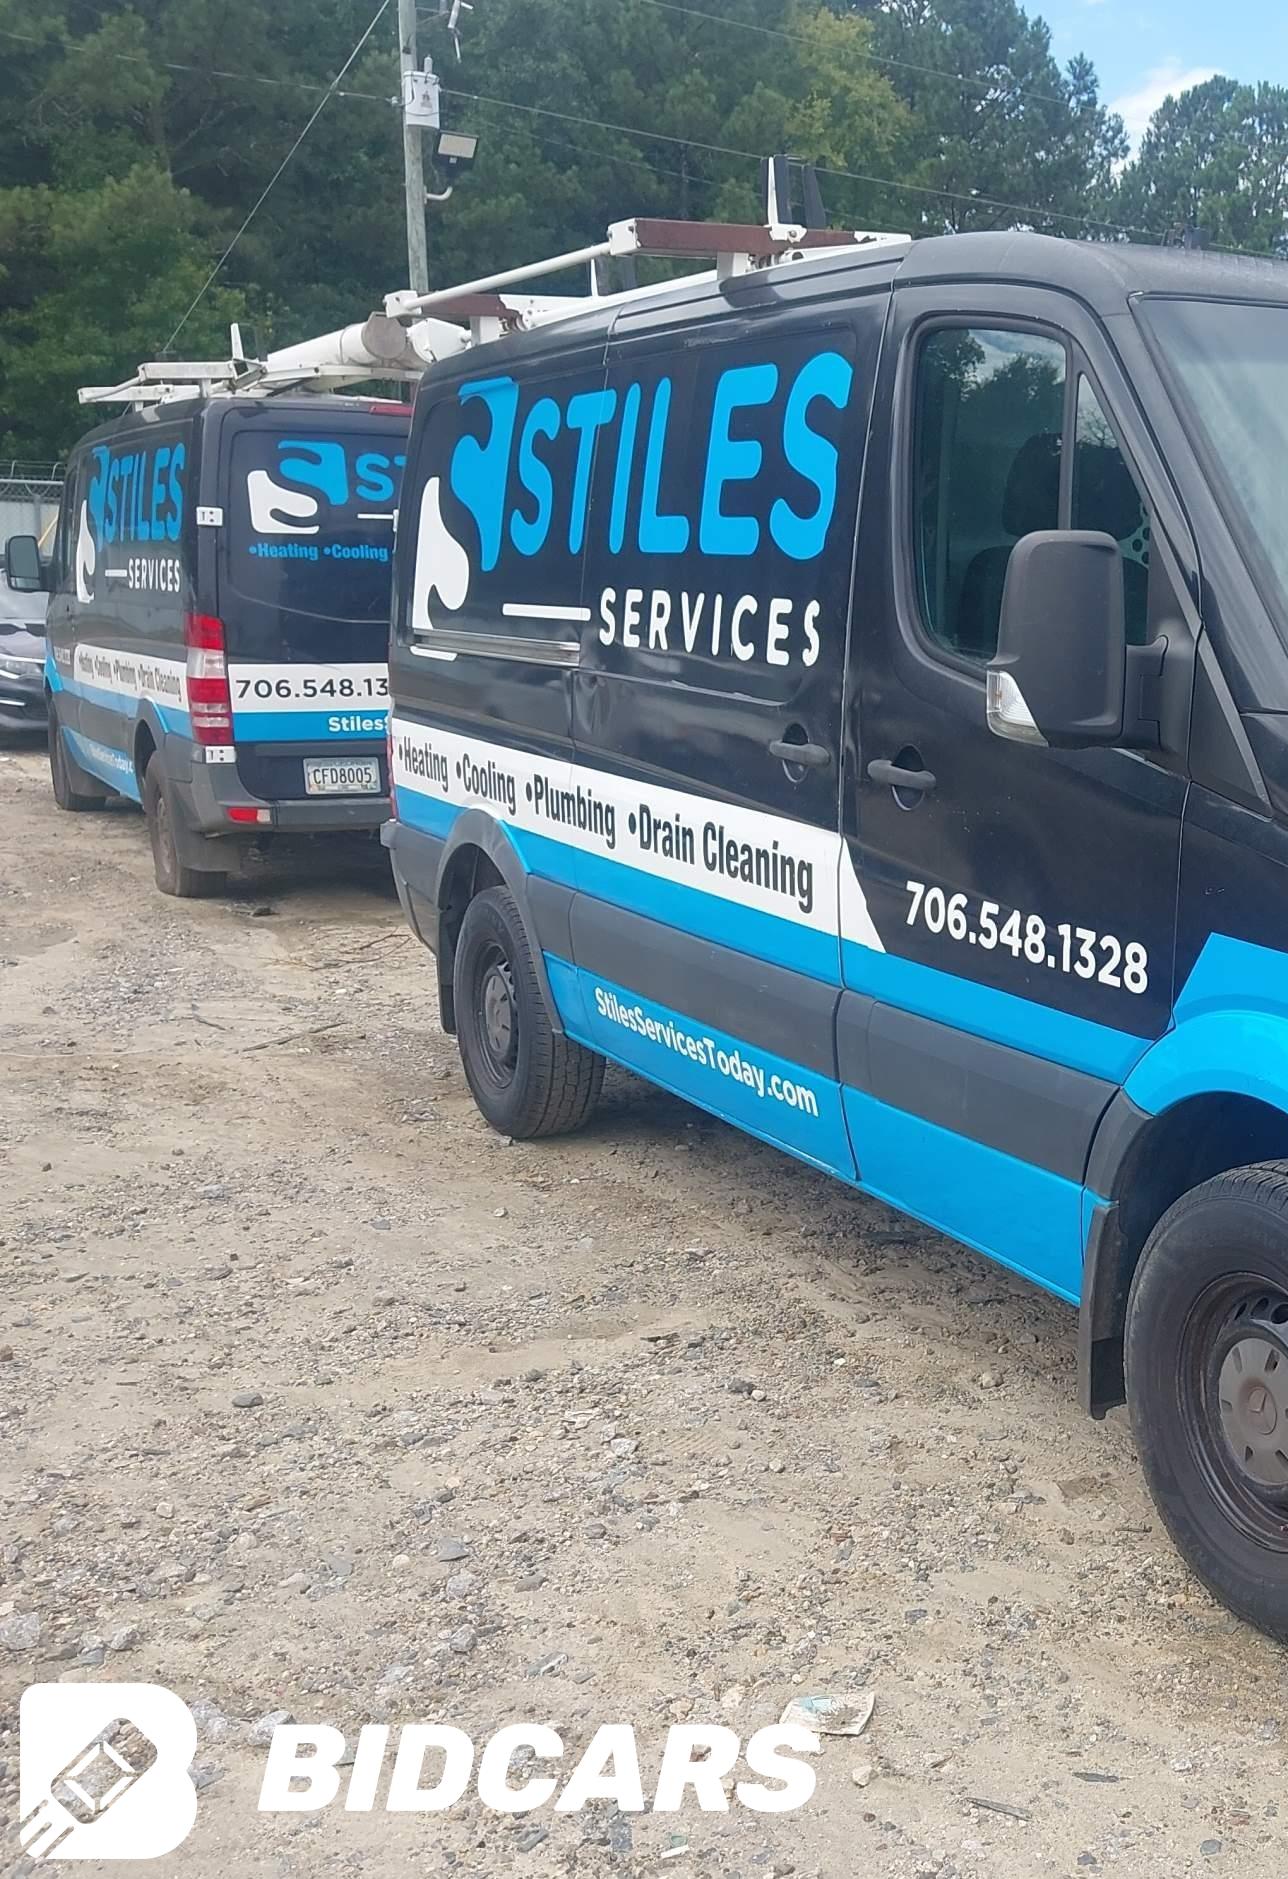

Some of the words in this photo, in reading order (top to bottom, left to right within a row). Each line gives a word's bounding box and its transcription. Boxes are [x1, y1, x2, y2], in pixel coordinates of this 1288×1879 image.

[104, 443, 186, 544] STILES
[510, 351, 854, 560] STILES
[128, 558, 181, 592] SERVICES
[598, 586, 821, 667] SERVICES
[235, 678, 388, 699] 706.548.13
[313, 767, 372, 784] CFD8005
[703, 820, 814, 914] Cleaning
[905, 879, 1148, 994] 706.548.1328
[594, 986, 820, 1118] StilesServicesToday.com
